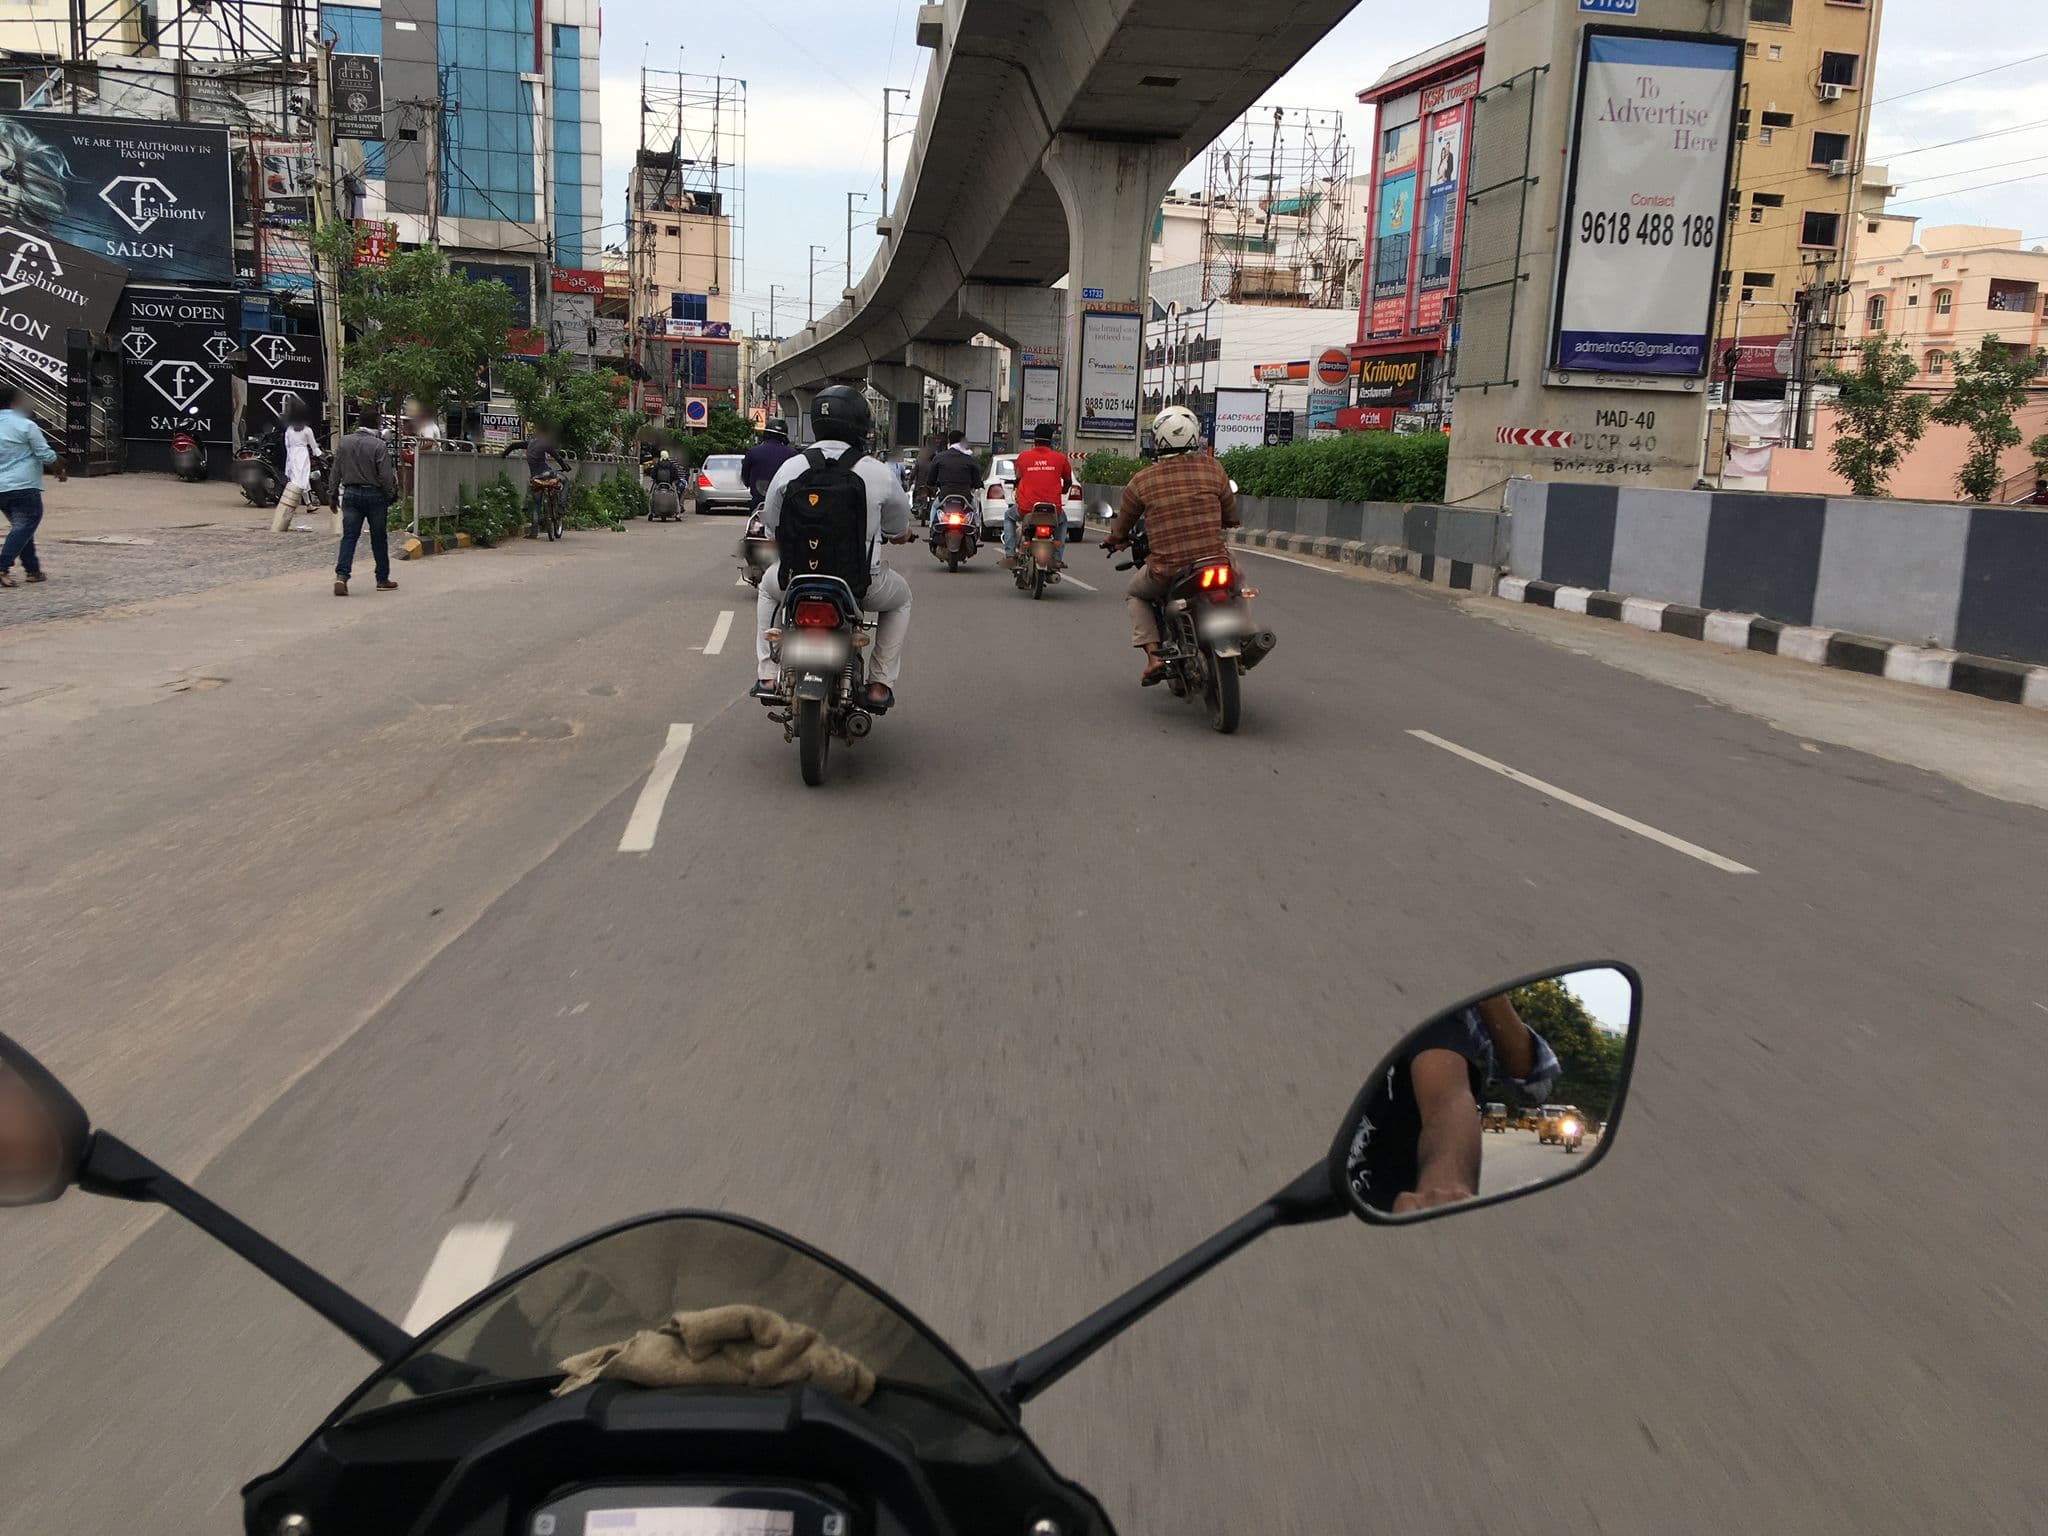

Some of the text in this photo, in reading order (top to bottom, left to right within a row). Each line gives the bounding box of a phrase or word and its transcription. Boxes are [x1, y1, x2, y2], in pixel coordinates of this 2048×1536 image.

[1423, 80, 1477, 110] KSR TOWERS
[1637, 76, 1660, 99] To
[1598, 96, 1709, 128] Advertise
[93, 138, 111, 148] ARE
[114, 139, 134, 150] THE
[1673, 129, 1718, 152] Here
[120, 149, 166, 161] FASHION
[131, 182, 207, 220] fashiontv
[1631, 193, 1675, 207] Contact
[1581, 211, 1714, 248] 9618 488 188
[106, 241, 174, 259] SALON
[131, 303, 225, 321] NOW OPEN
[269, 339, 312, 363] fashiontv
[1575, 340, 1699, 358] admetro55@gmail.com
[1362, 360, 1417, 387] Kritunga
[1085, 397, 1134, 411] 9885 025 144
[483, 415, 520, 426] NOTARY
[1365, 412, 1380, 424] airtel
[1596, 409, 1655, 429] MAD-40
[1215, 424, 1263, 433] 7396001111
[1629, 435, 1657, 452] 40
